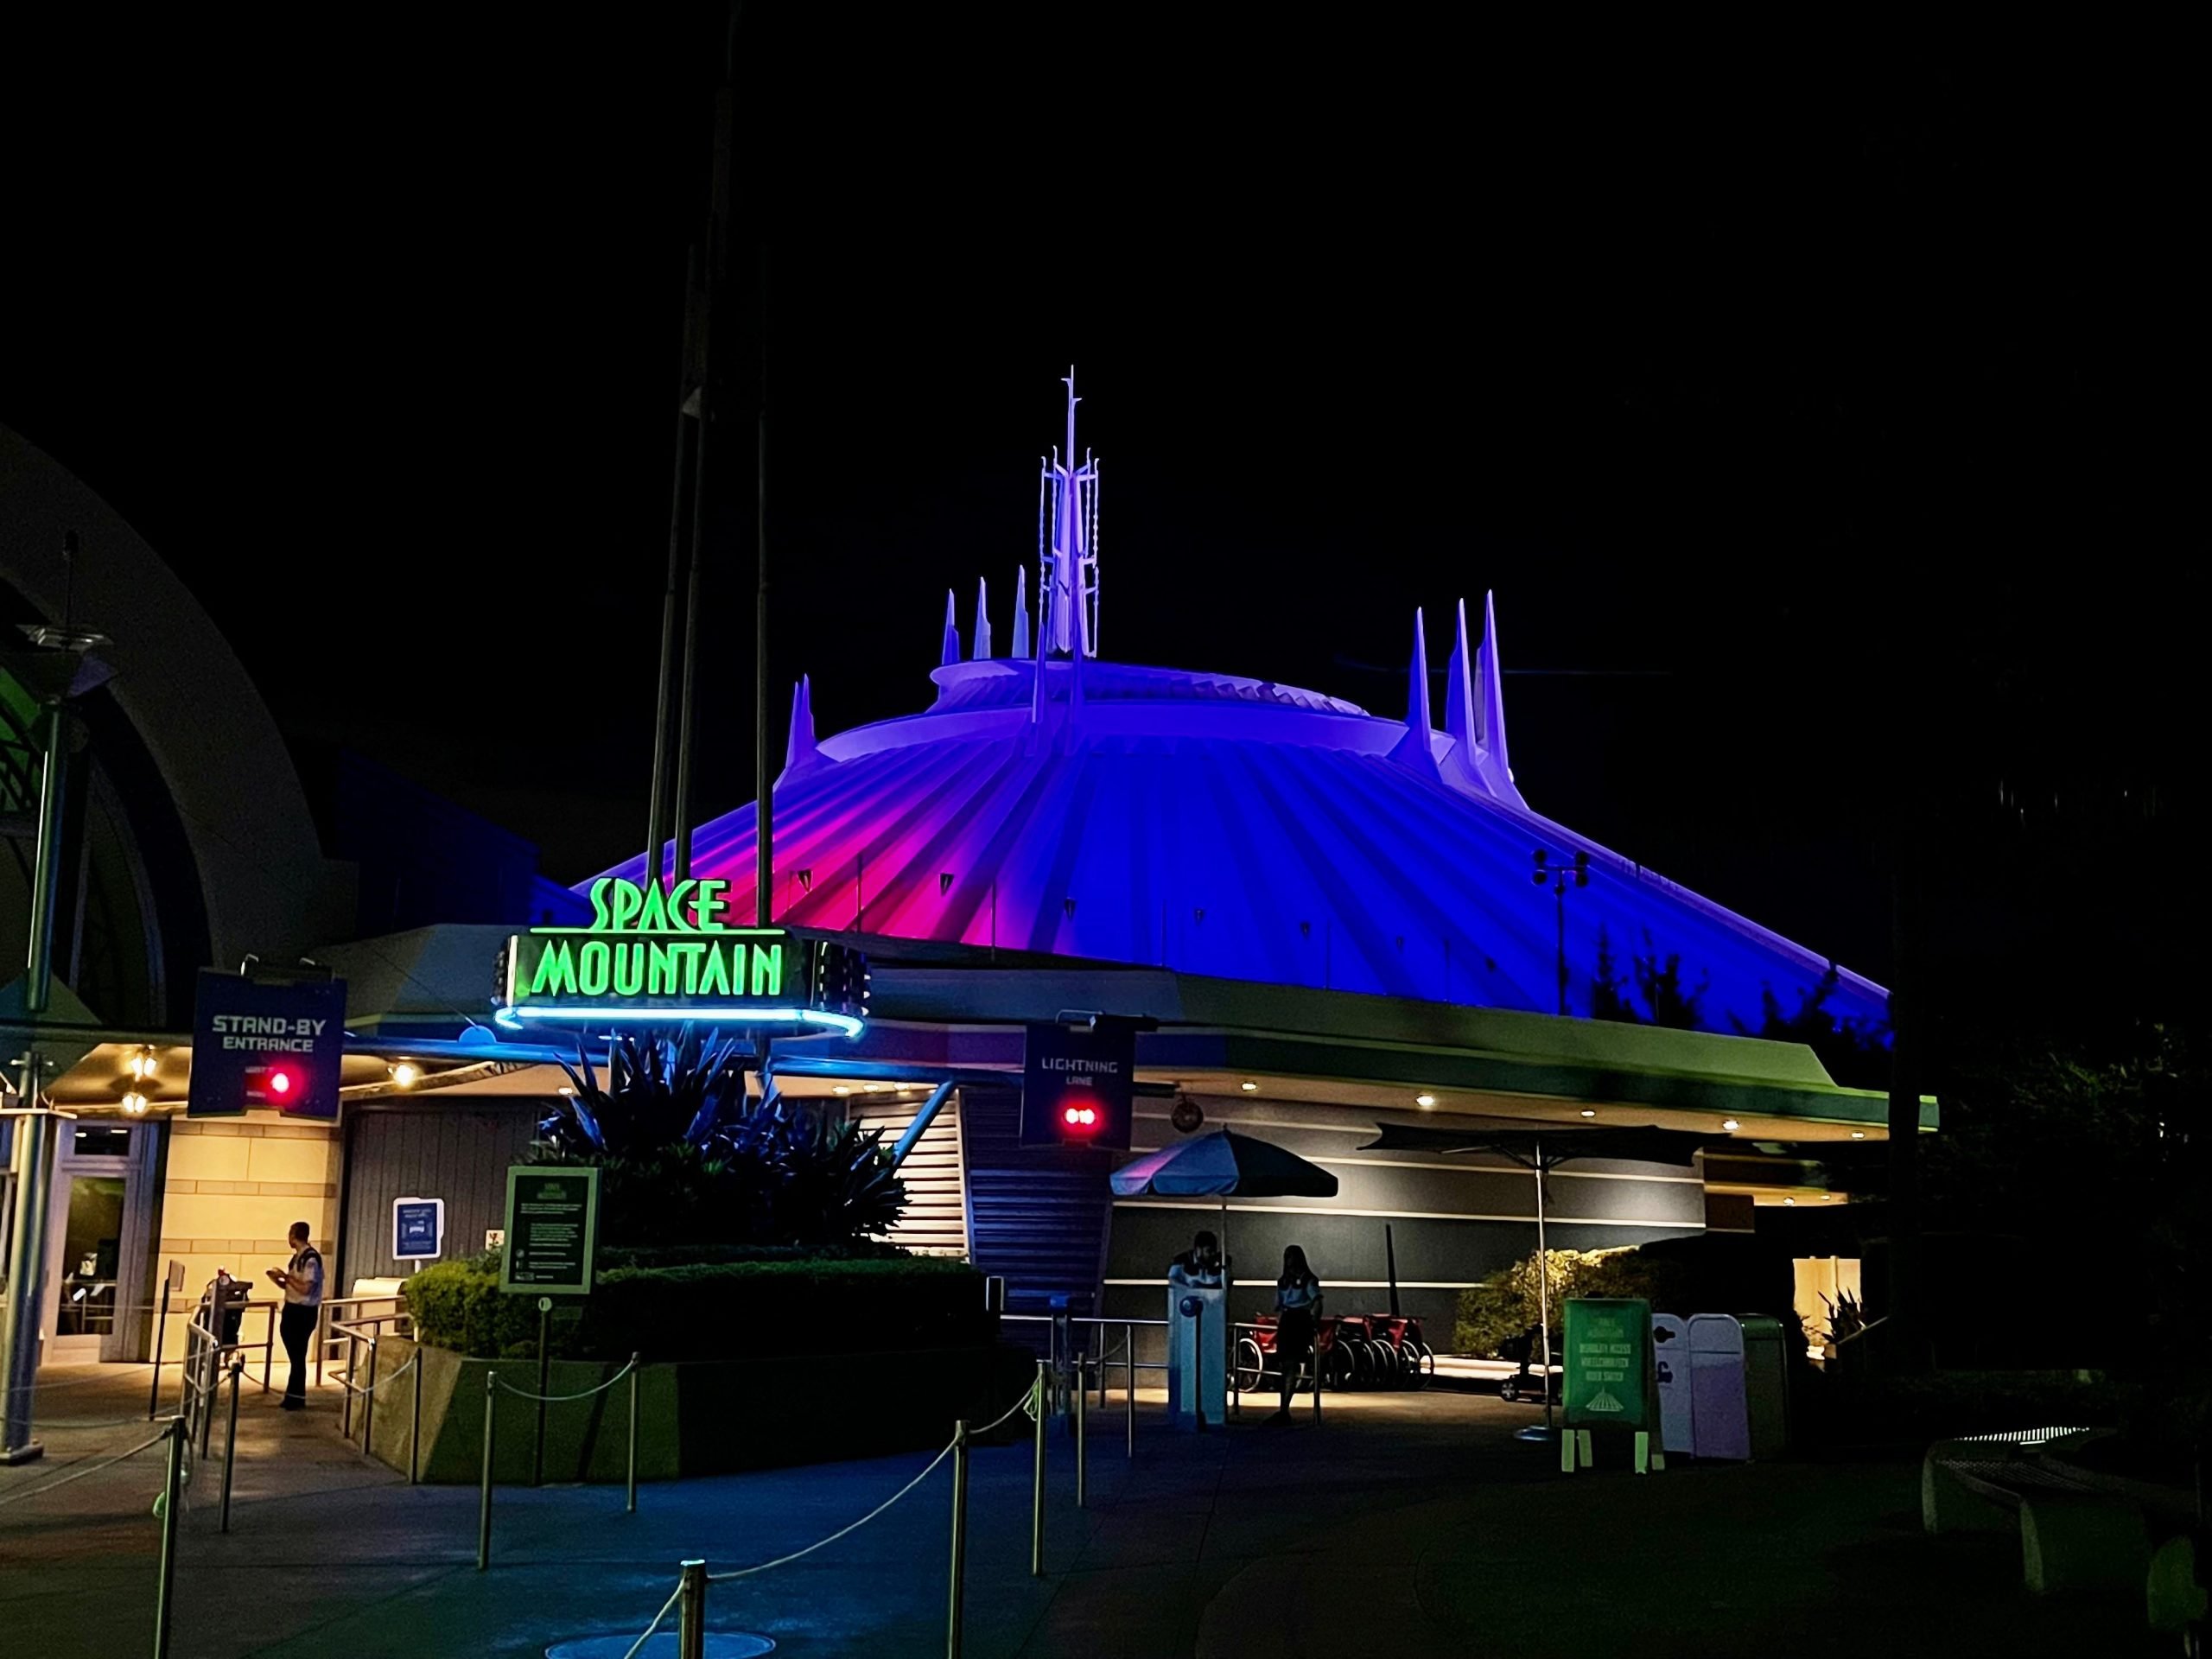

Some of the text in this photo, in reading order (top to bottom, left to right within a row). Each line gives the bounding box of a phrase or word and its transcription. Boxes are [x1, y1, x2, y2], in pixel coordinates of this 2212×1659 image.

[589, 878, 726, 931] SPACE
[531, 940, 783, 996] MOUNTAIN
[213, 1014, 326, 1035] STAND-BY
[223, 1036, 314, 1052] ENTRANCE
[1042, 1058, 1117, 1073] LIGHTNING
[1066, 1077, 1092, 1085] LANE
